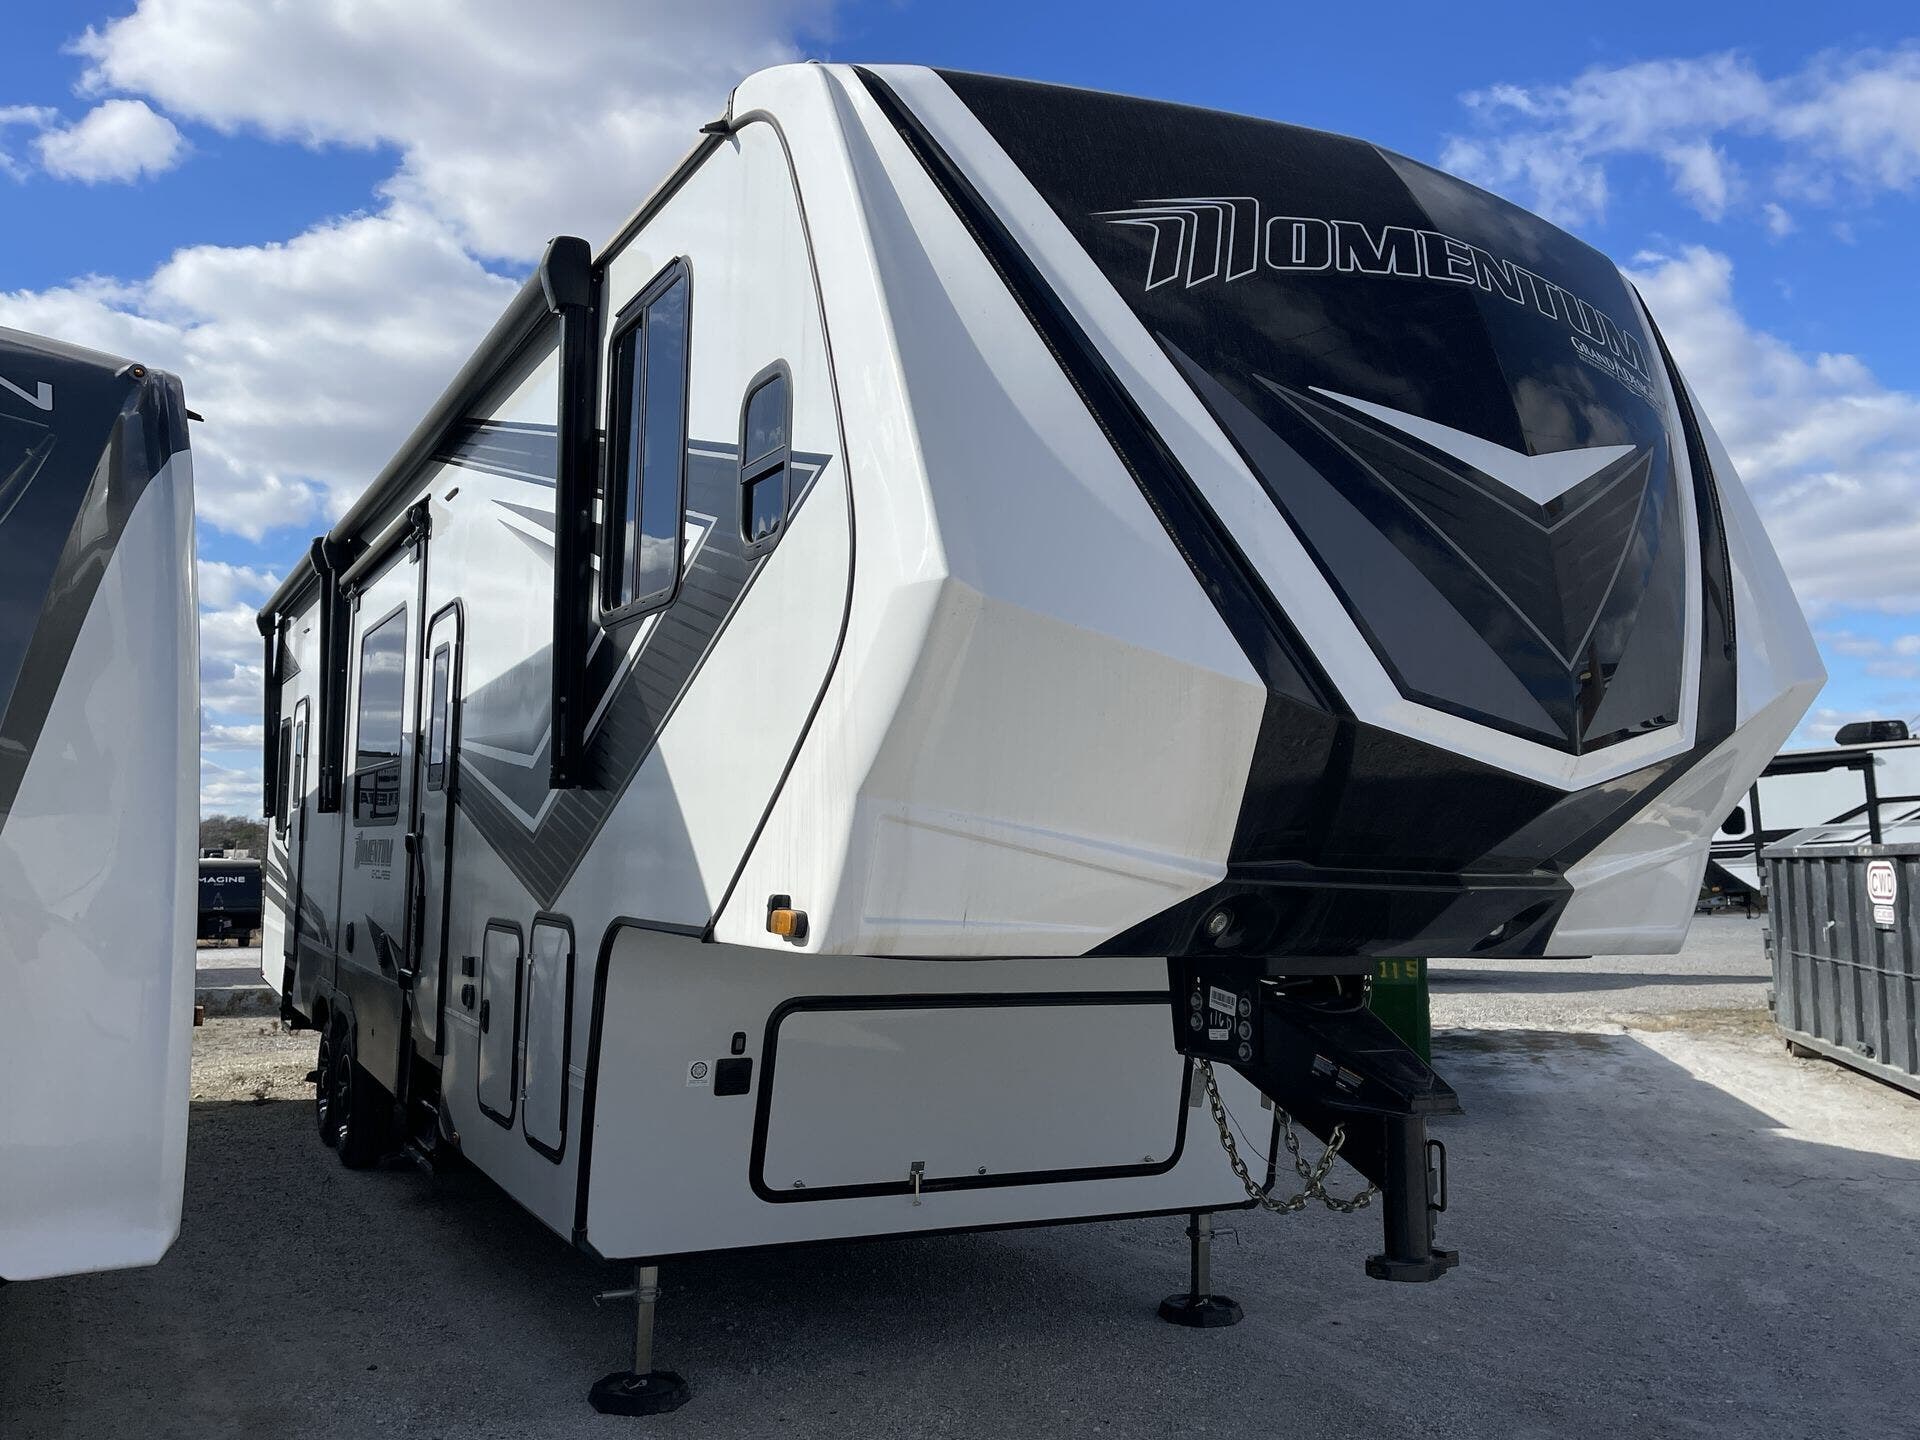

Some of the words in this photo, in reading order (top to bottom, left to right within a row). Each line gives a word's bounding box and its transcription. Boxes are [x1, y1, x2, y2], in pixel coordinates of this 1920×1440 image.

[1089, 196, 1651, 382] MOMENTUM
[199, 876, 245, 884] MAGINE
[1872, 873, 1894, 893] CWD
